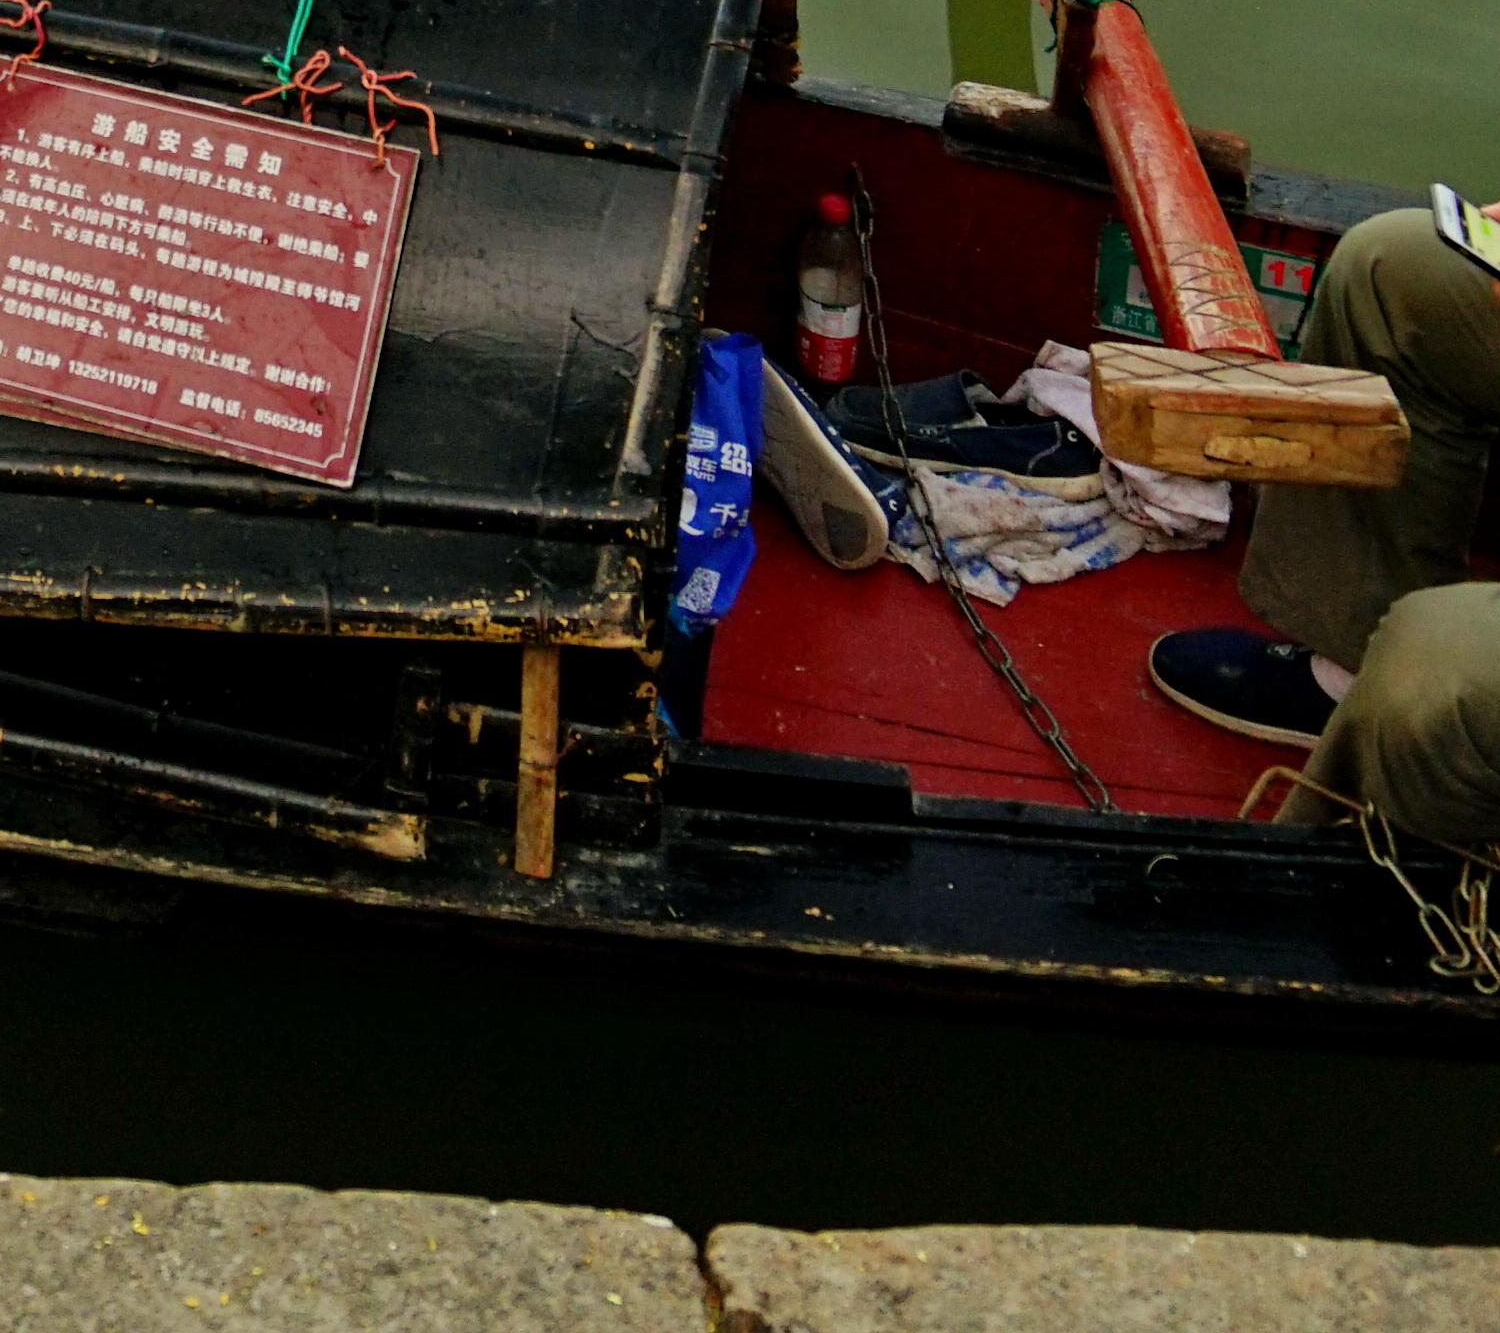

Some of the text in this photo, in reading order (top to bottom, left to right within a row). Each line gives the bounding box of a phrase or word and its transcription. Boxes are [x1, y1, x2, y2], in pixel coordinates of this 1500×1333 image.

[89, 110, 284, 179] 游船安全需知
[1268, 260, 1313, 294] 11
[66, 357, 158, 397] 13252119718
[720, 441, 753, 477] 绍
